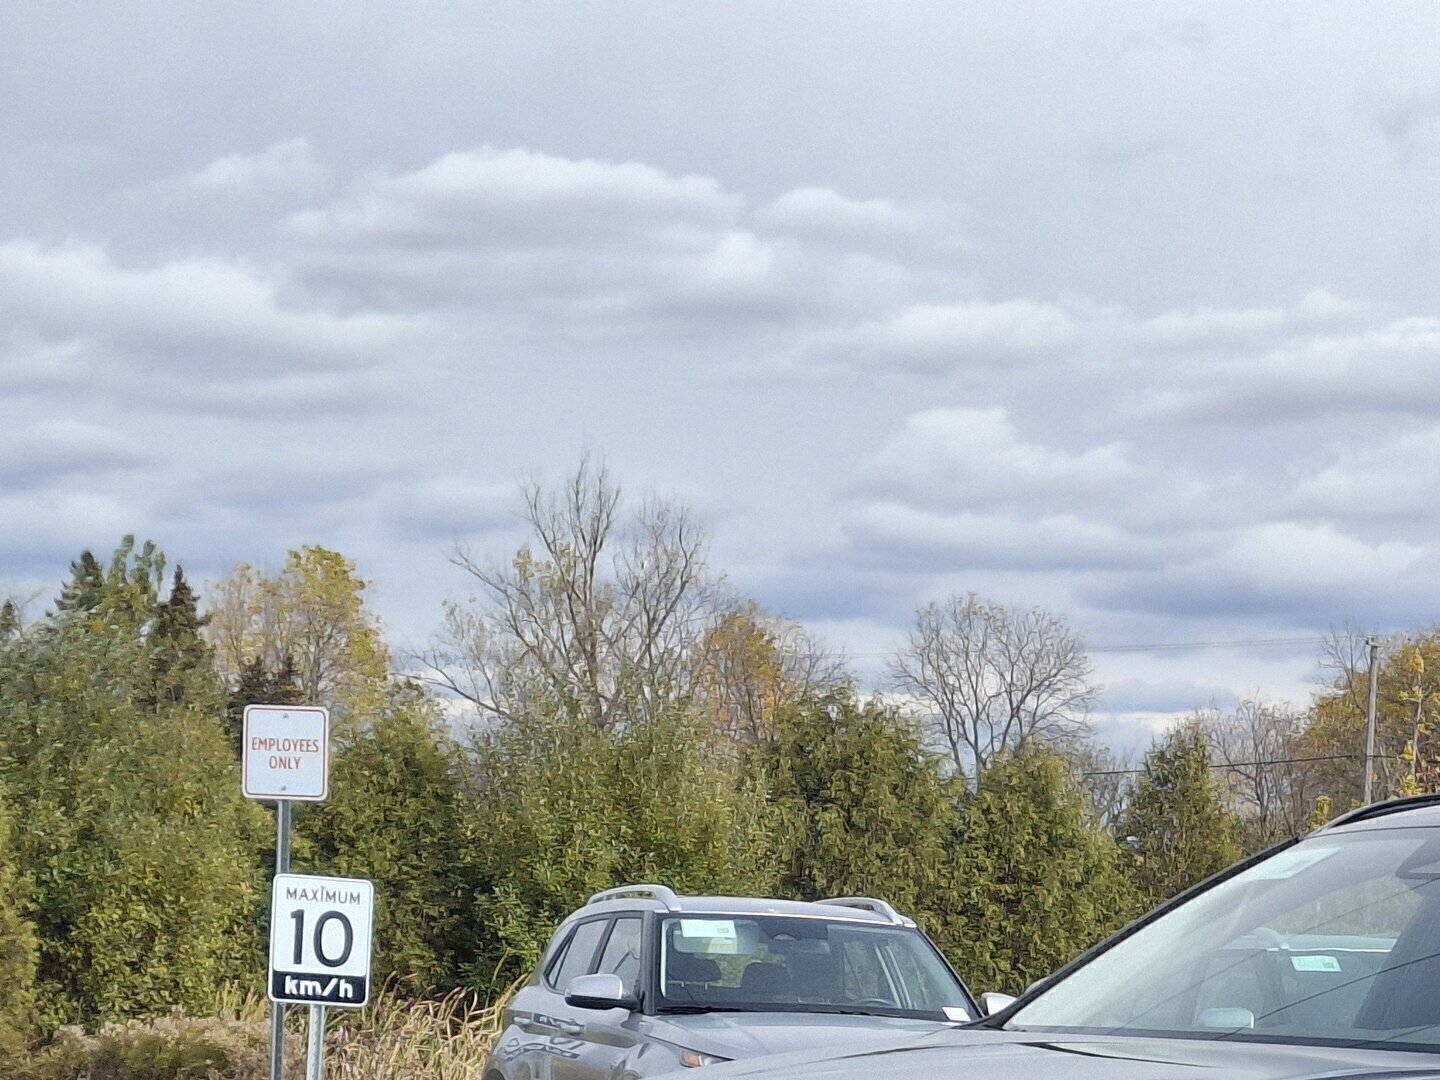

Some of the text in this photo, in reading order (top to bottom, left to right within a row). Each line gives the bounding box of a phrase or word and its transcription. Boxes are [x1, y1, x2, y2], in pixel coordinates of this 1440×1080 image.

[251, 737, 319, 753] EMPLOYEES
[269, 755, 301, 770] ONLY
[286, 886, 361, 905] MAXIMUM
[290, 908, 354, 968] 10
[284, 975, 354, 999] km/h
